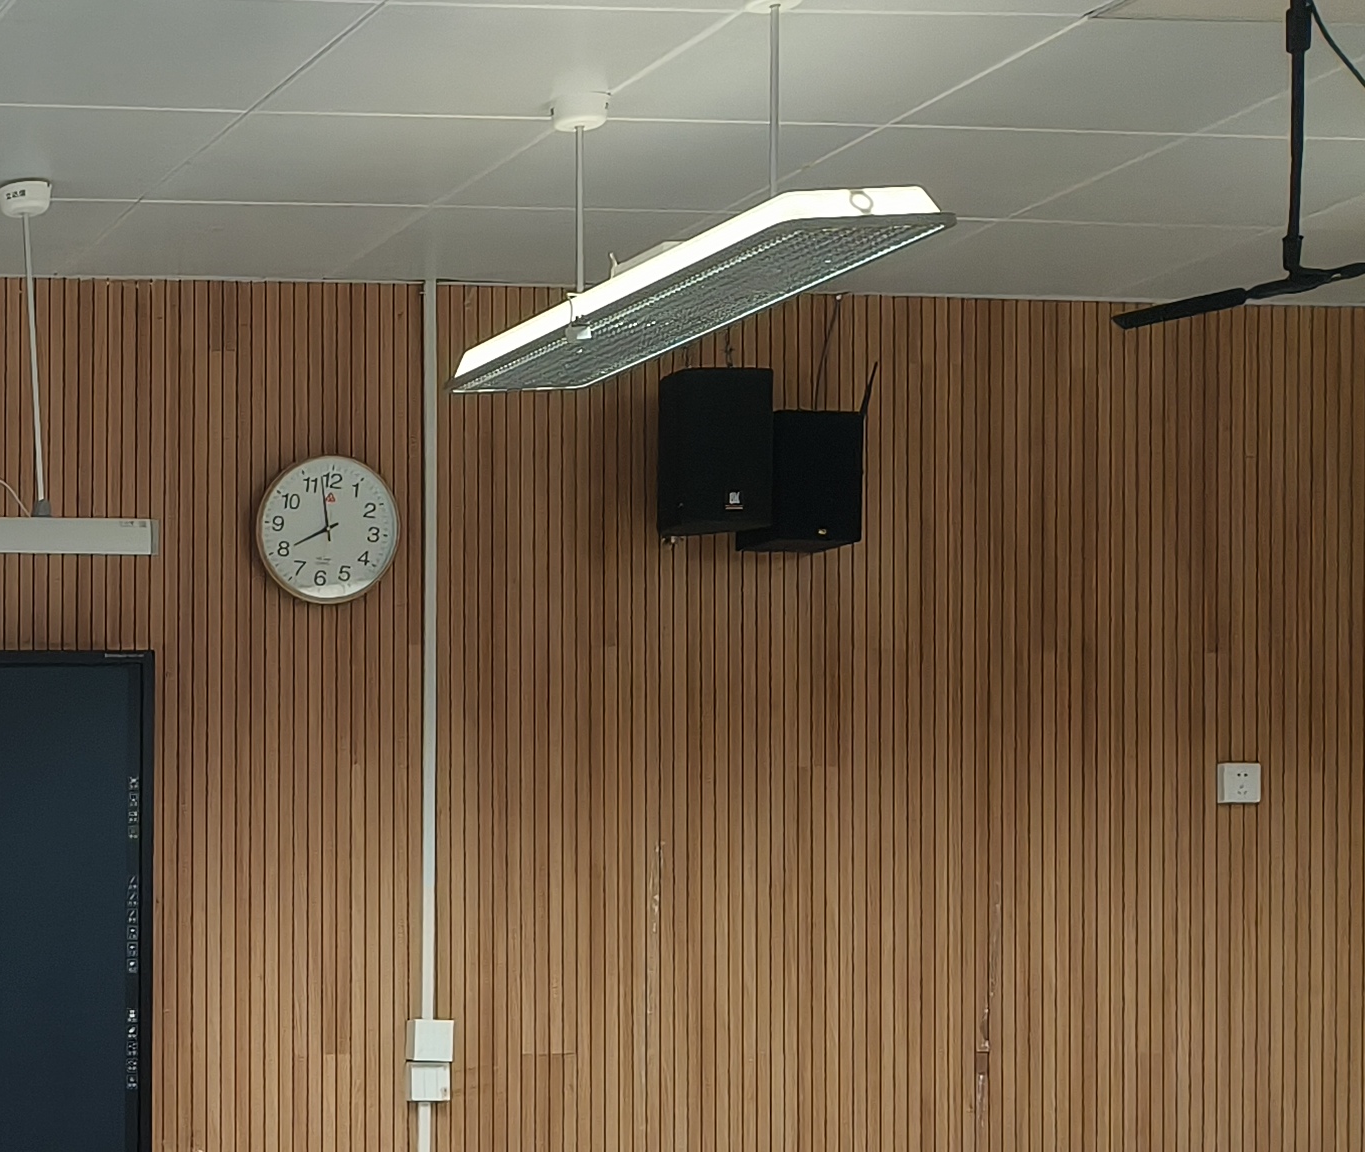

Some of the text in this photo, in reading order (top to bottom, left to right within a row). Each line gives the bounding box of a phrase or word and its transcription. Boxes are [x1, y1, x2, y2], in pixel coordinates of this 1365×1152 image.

[303, 477, 318, 493] 11
[323, 472, 342, 489] 12
[352, 483, 359, 498] 1
[282, 493, 300, 510] 10
[363, 502, 376, 519] 2
[272, 515, 284, 531] 9
[367, 527, 380, 543] 3
[277, 541, 290, 556] 8
[357, 551, 370, 566] 4
[294, 560, 306, 576] 7
[338, 565, 351, 581] 5
[314, 570, 326, 586] 6
